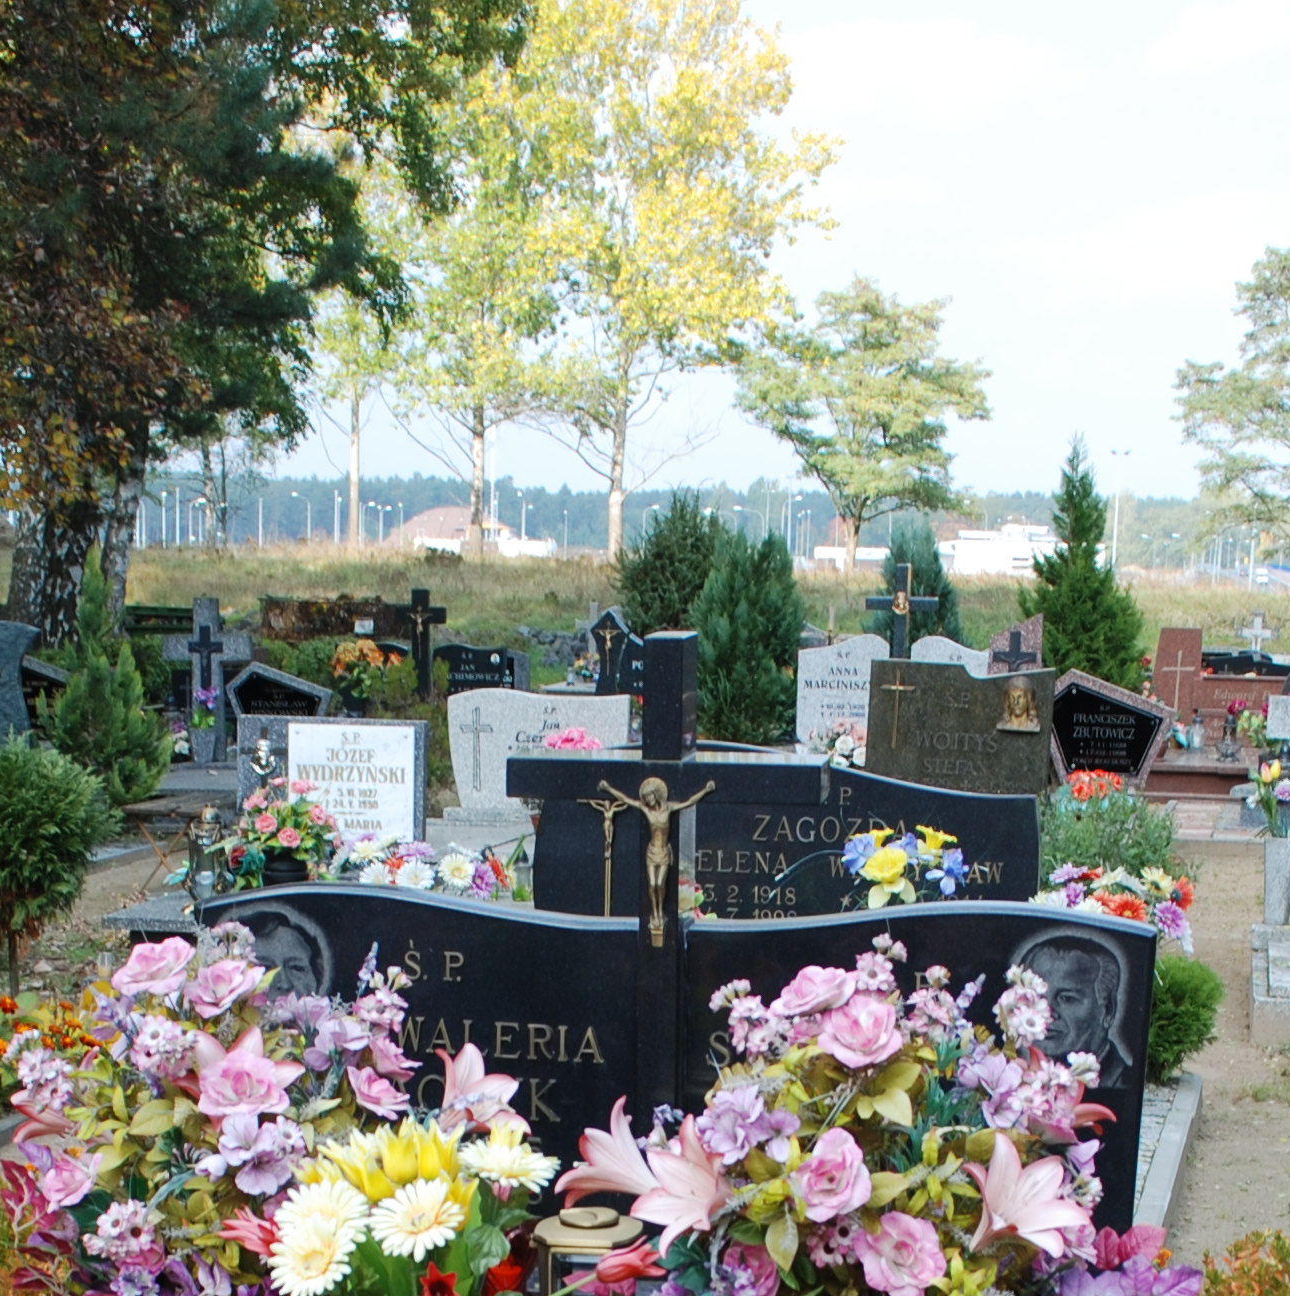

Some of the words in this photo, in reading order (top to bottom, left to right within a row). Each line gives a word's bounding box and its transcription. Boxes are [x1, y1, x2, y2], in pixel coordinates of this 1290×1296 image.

[829, 667, 859, 676] ANNA
[804, 680, 870, 691] MARCINISZ
[1073, 712, 1135, 724] FRANCISZEK
[539, 720, 560, 733] Jan
[326, 745, 375, 763] JÓZEF
[297, 763, 406, 784] WYDRZYŃSKI
[924, 759, 987, 777] STEFAN
[344, 818, 383, 831] MARIA
[397, 1016, 605, 1064] WALERIA
